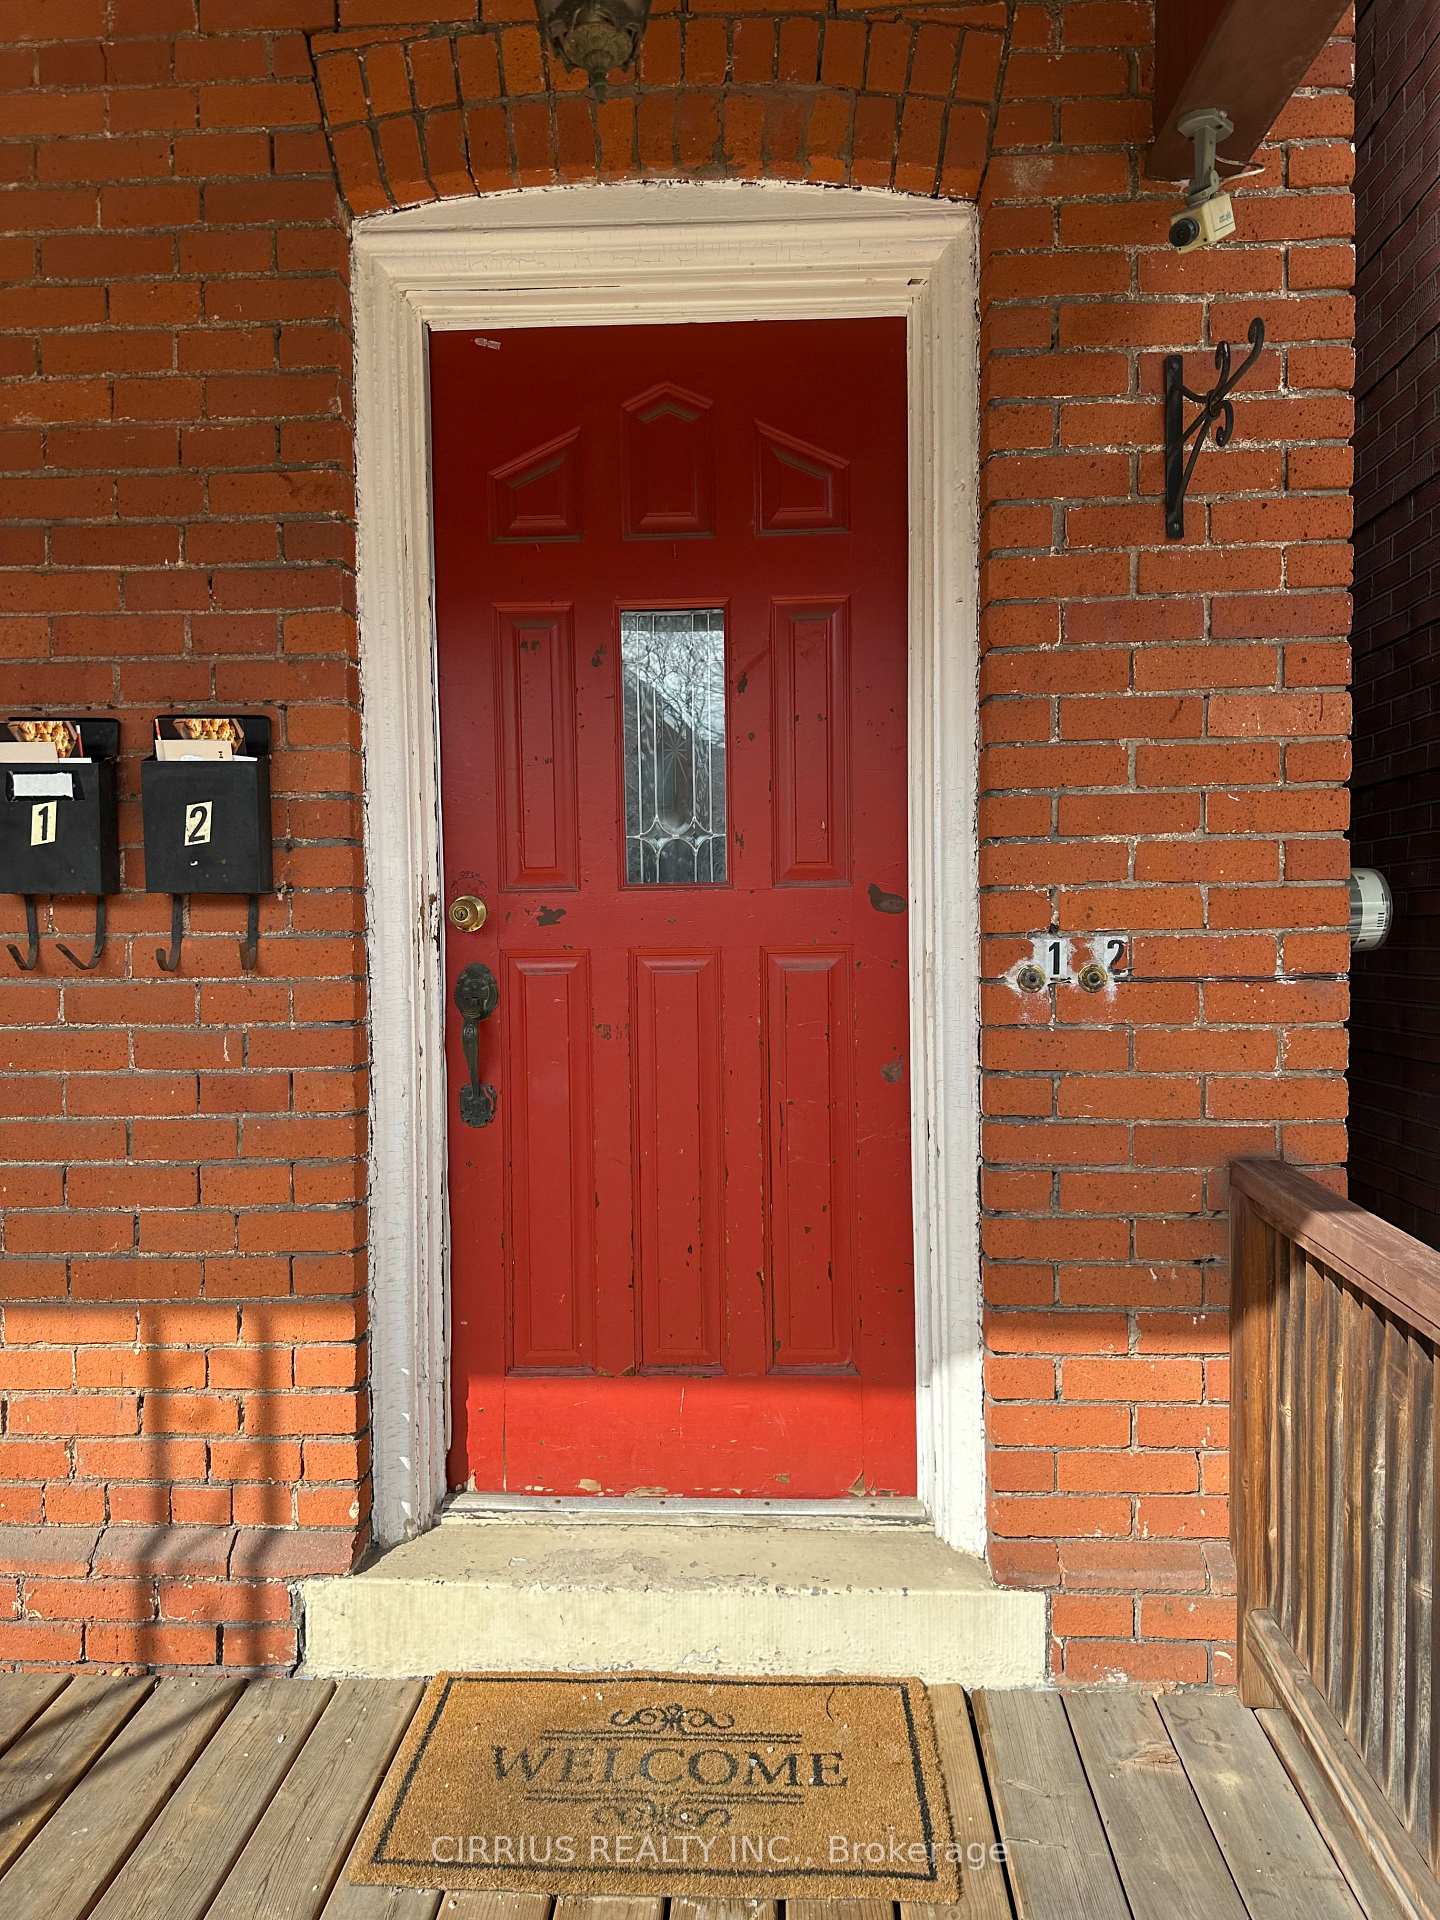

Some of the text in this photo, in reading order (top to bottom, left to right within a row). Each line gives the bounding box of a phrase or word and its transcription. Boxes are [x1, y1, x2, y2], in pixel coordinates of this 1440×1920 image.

[38, 805, 49, 841] 1
[188, 806, 208, 843] 2
[1048, 941, 1061, 975] 1
[1107, 939, 1127, 975] 2
[493, 1746, 849, 1787] WELCOME
